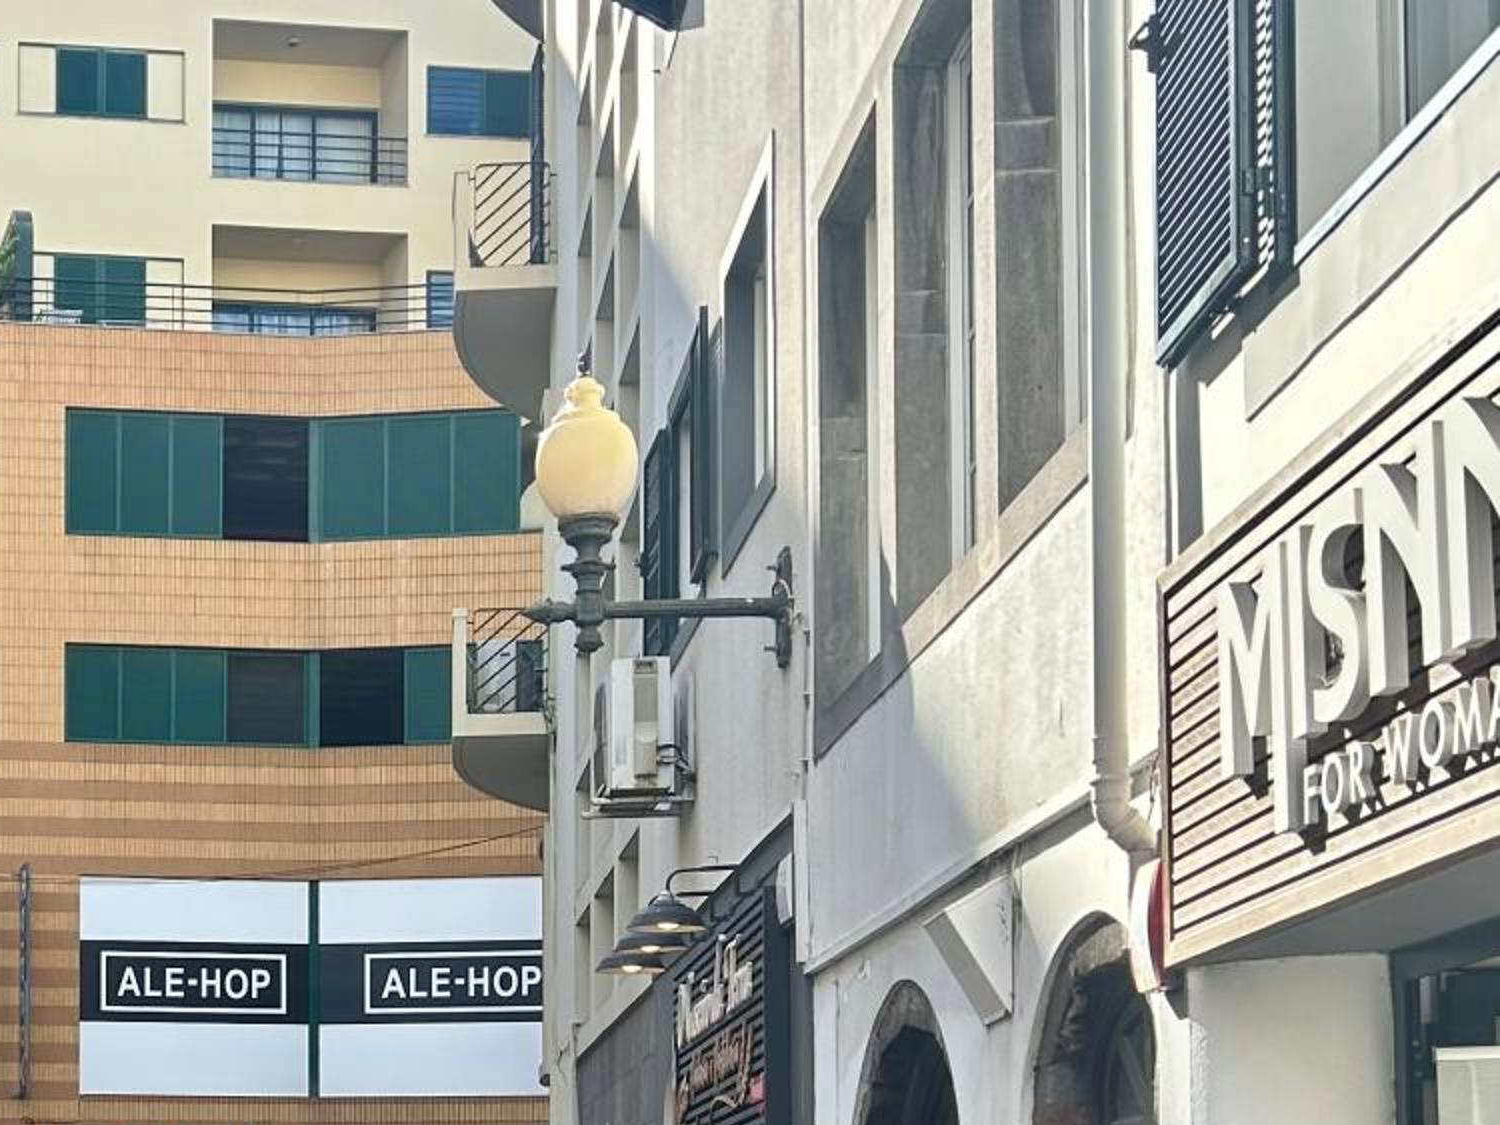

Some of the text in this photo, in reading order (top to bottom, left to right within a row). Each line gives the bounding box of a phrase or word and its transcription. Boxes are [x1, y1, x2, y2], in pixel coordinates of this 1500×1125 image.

[1303, 740, 1374, 826] FOR
[117, 966, 272, 1000] ALE-HOP
[380, 965, 542, 1000] ALE-HOP
